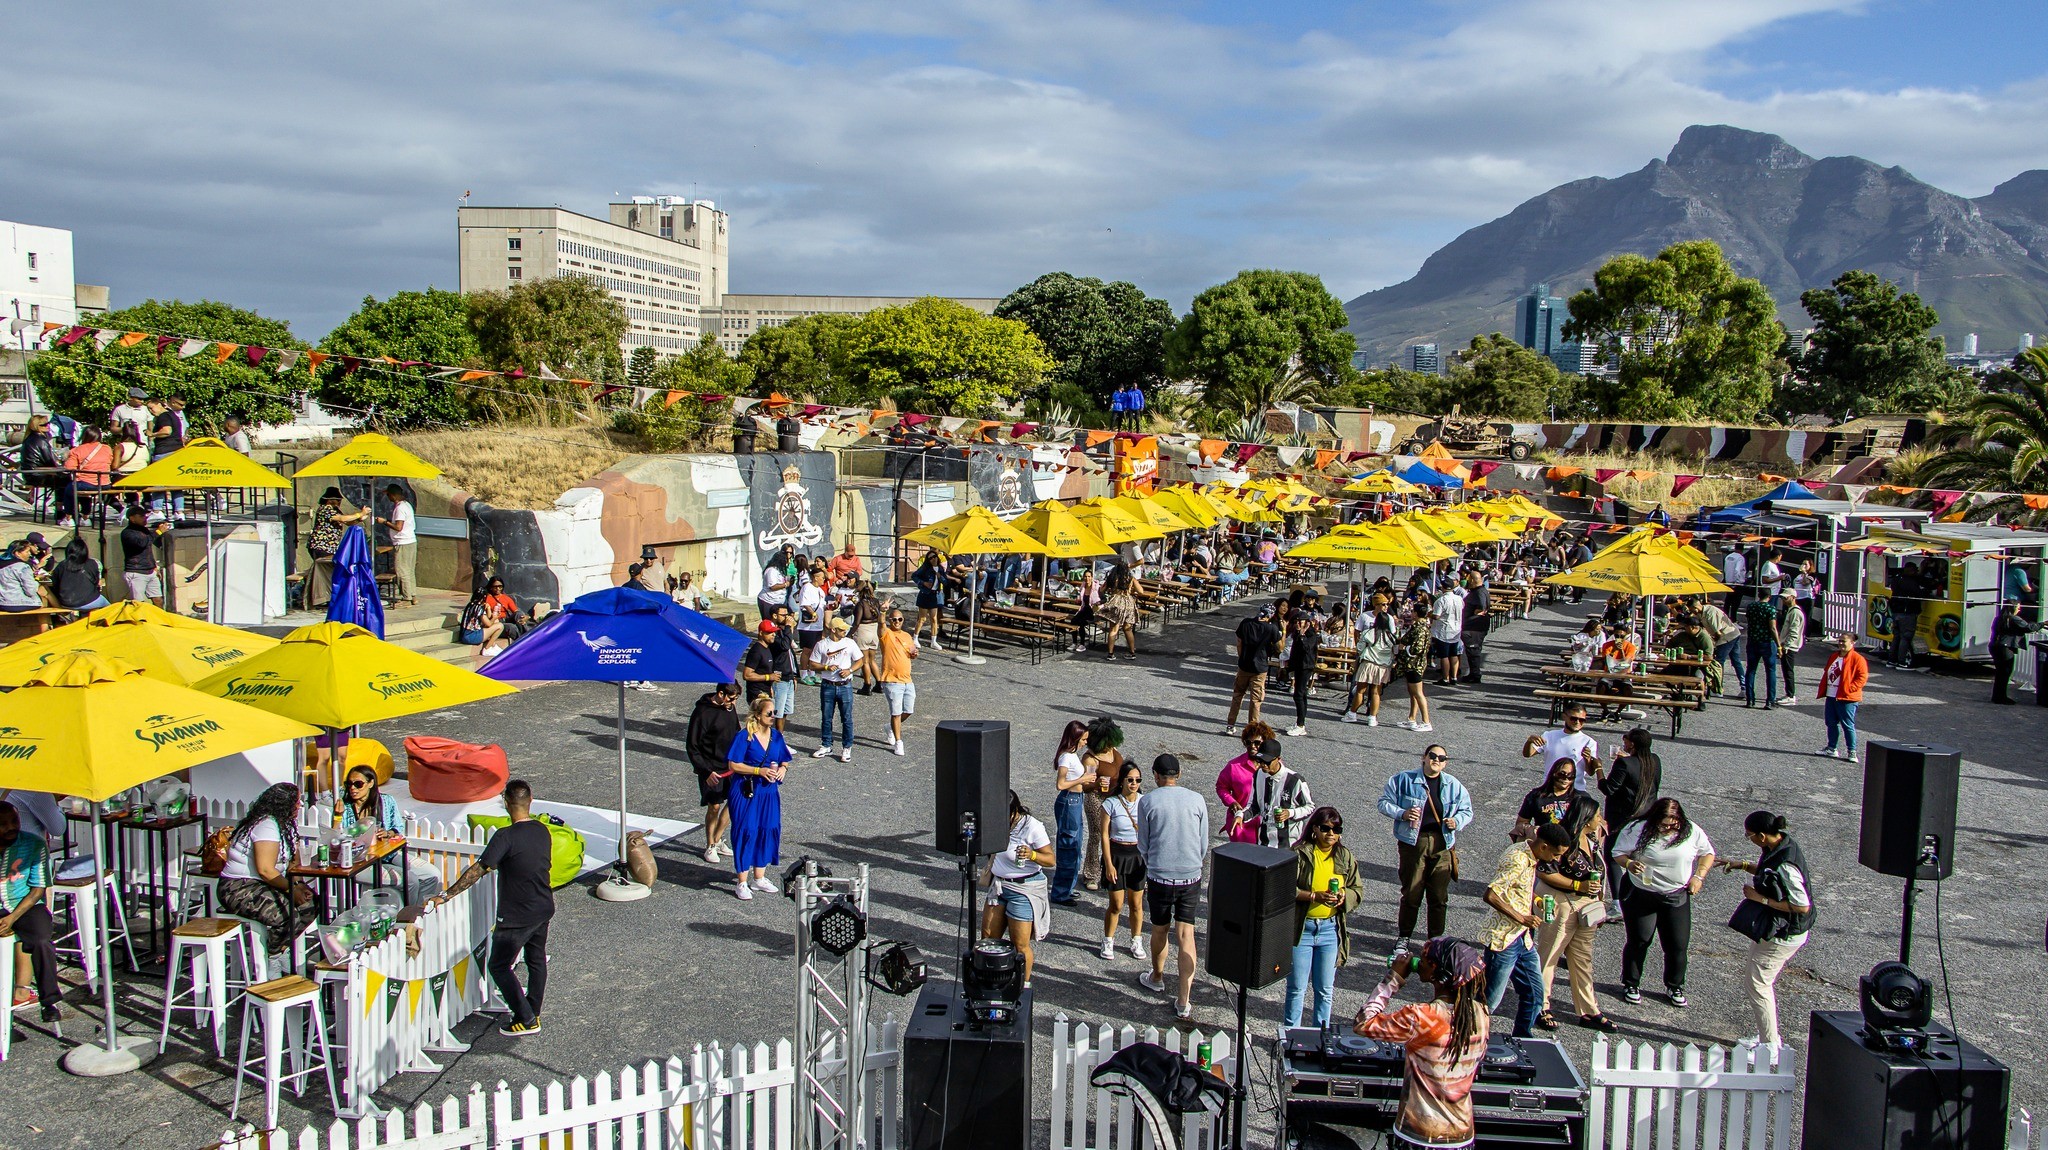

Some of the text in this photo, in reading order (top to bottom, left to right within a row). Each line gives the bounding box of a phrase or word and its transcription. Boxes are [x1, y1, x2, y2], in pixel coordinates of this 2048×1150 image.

[343, 457, 388, 466] Savanna
[177, 465, 233, 476] Savanna
[978, 534, 1014, 545] Savanna
[1585, 570, 1621, 581] Savanna
[220, 676, 294, 698] Savanna
[368, 678, 438, 700] Savanna
[135, 719, 225, 753] Savanna
[176, 739, 205, 749] PREMIUM
[186, 744, 207, 753] CIDER
